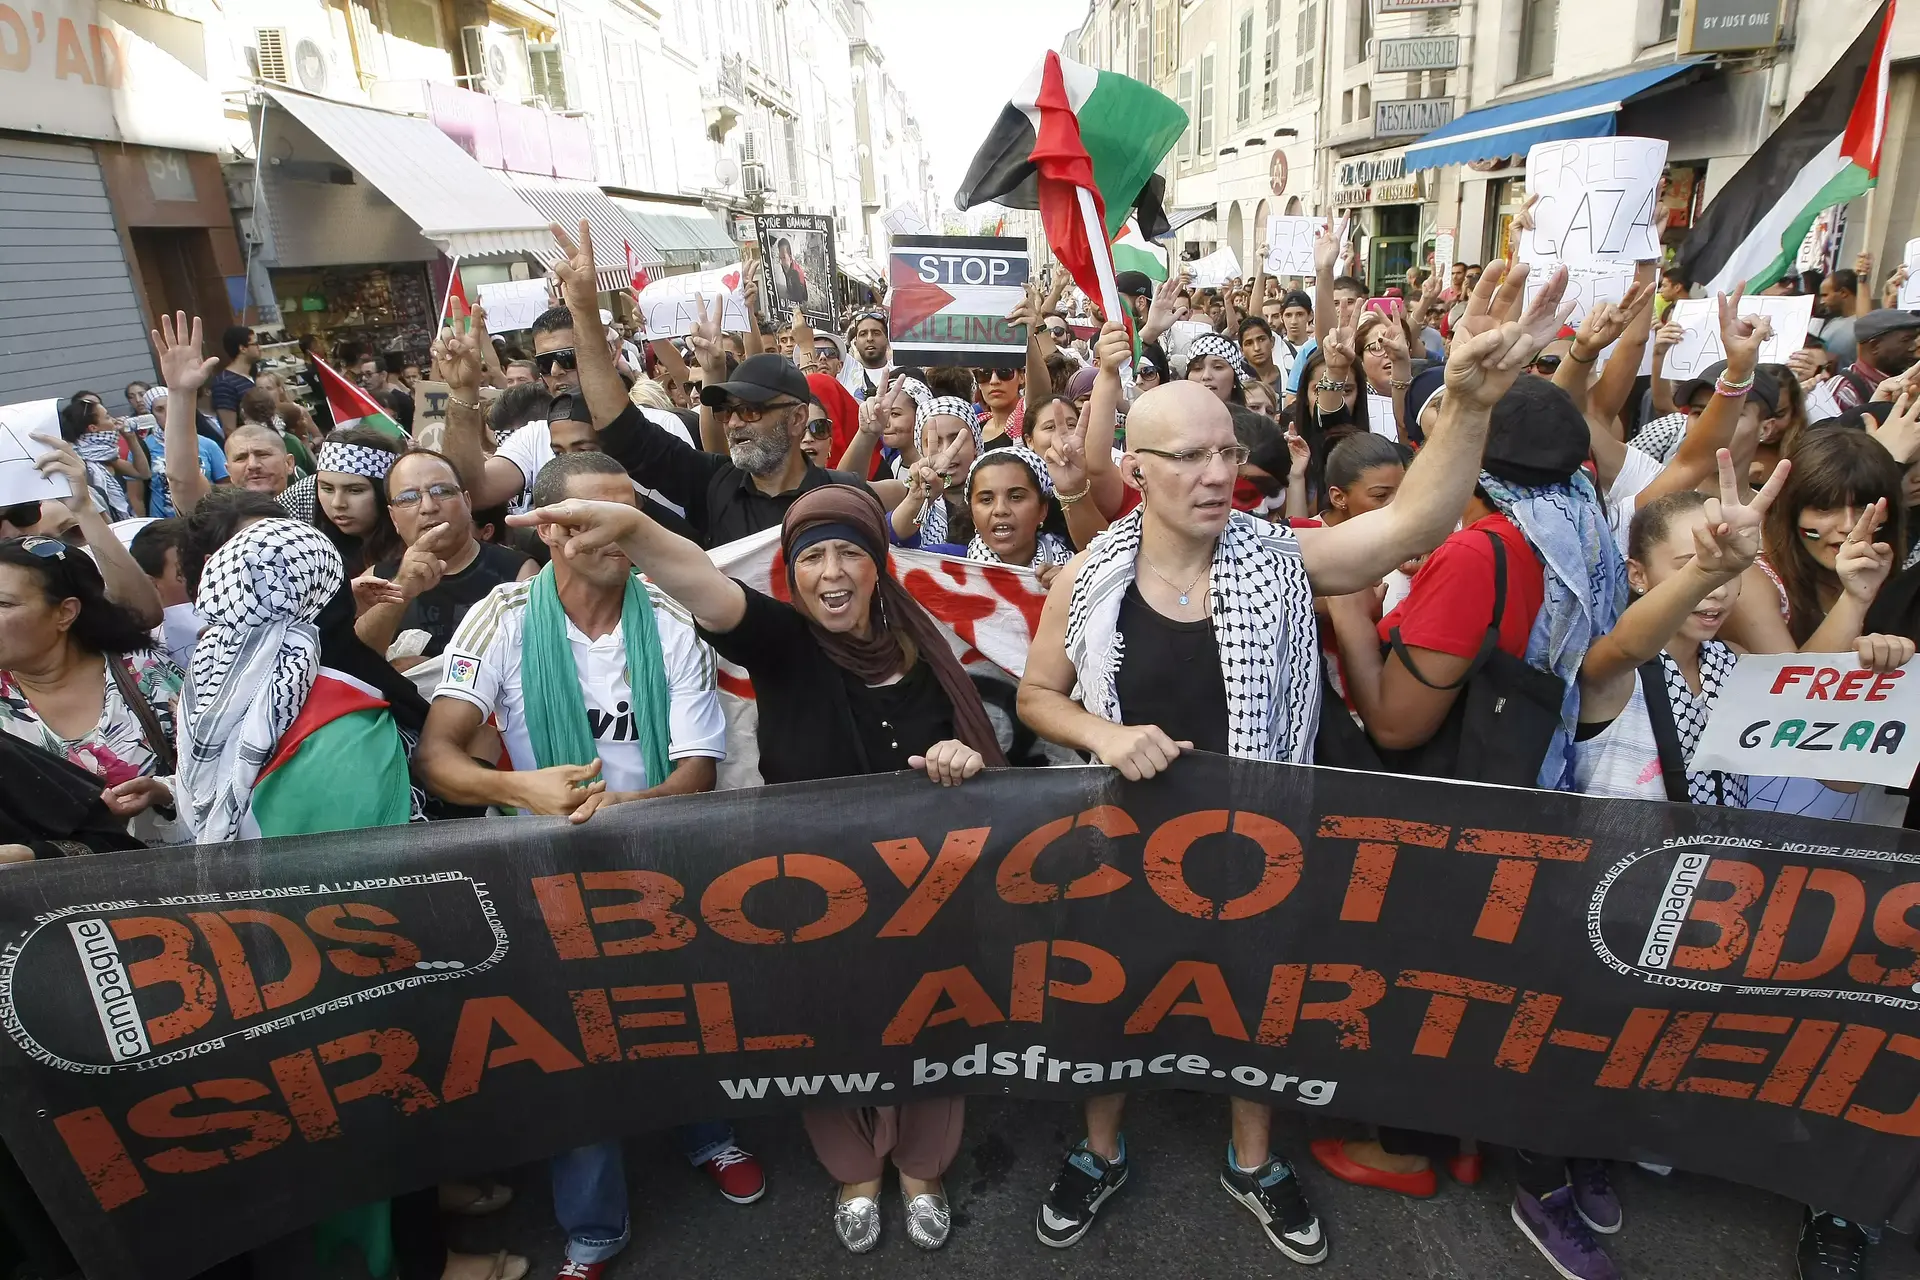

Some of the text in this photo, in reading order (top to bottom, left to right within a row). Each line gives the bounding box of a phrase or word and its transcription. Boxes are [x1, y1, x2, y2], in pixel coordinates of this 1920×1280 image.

[1703, 12, 1770, 28] BY JUST ONE
[1384, 40, 1454, 68] PATISSERIE
[1379, 102, 1449, 131] RESTAURANT
[1533, 140, 1637, 194] FREE
[1377, 184, 1416, 200] PATISSERIE
[1533, 187, 1654, 259] GAZA
[918, 256, 1010, 285] STOP
[1268, 249, 1315, 273] GAZ
[1671, 327, 1779, 374] GAA
[1769, 666, 1905, 701] FREE
[1739, 718, 1907, 755] GAZAA
[1663, 834, 1763, 849] SANCTIONS
[1781, 842, 1840, 855] NOTRE
[531, 804, 1594, 960] BOYCOTT
[34, 899, 140, 926] SANCTIONS
[159, 892, 220, 906] NOTRE
[225, 885, 311, 902] REPONSE
[318, 883, 331, 894] A
[1587, 851, 1639, 976] DESINVESTISSEMENT
[1645, 856, 1703, 967] campagne
[78, 921, 143, 1059] campagne
[1643, 973, 1723, 993] BOYCOTT
[1836, 991, 1920, 1010] CUPATION
[136, 1037, 226, 1072] BOYCOTT
[54, 939, 1920, 1213] ISRAEL APARTHEID
[718, 1043, 1338, 1106] www. bdsfrance.org
